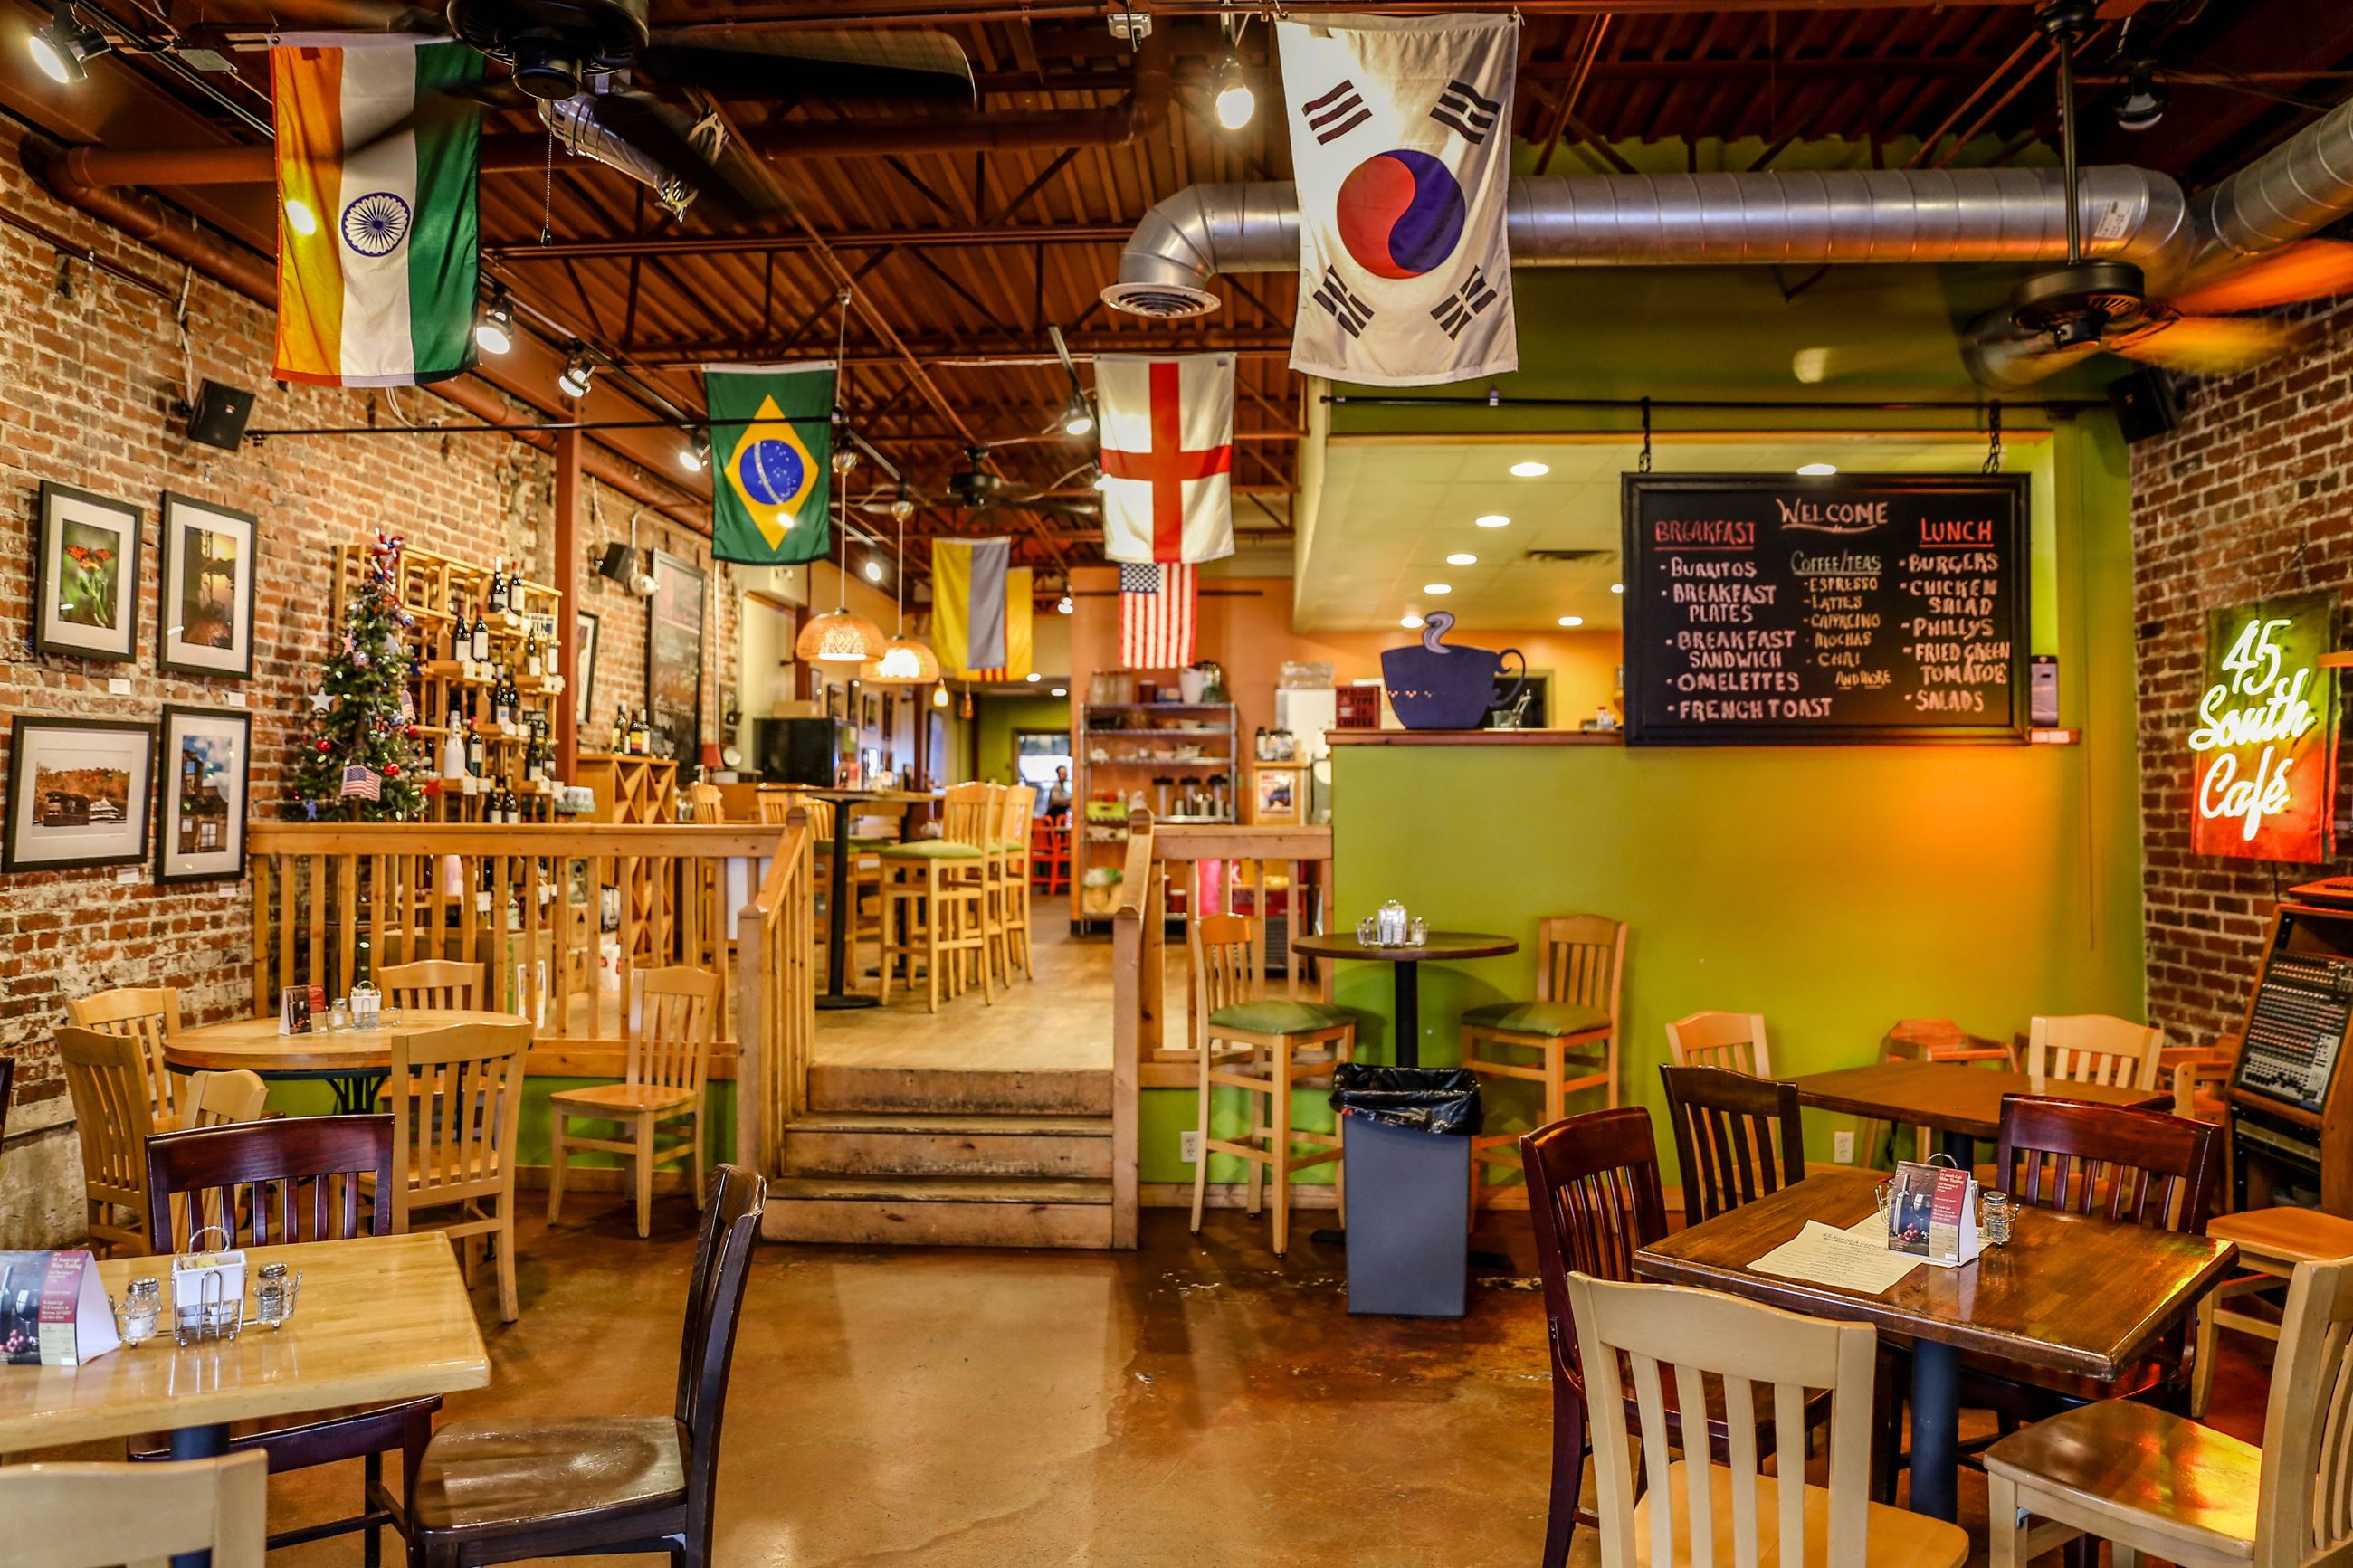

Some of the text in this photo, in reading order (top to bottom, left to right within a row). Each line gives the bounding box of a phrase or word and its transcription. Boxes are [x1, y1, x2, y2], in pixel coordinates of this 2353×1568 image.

[1776, 497, 1889, 525] WELCOME
[1654, 520, 1756, 545] BREAKFAST
[1920, 517, 1993, 542] LUNCH
[1671, 556, 1758, 579] BURRITOS
[1909, 552, 1999, 575] BURGERS
[1673, 584, 1777, 605] BREAKFAST
[1809, 576, 1879, 593] ESPRESSO
[1910, 578, 1998, 599] CHICKEN
[1688, 603, 1755, 624] PLATES
[1812, 594, 1863, 613] LATTES
[1929, 596, 1993, 616] SALAD
[1913, 616, 1995, 641] PHILLYS
[1677, 630, 1796, 651] BREAKFAST
[1815, 631, 1872, 649] MOCHAS
[1688, 650, 1783, 669] SANDWICH
[1817, 651, 1862, 668] CHAI
[1915, 641, 2010, 663] FRIED GREEN
[2222, 619, 2292, 696] 45
[1677, 672, 1800, 693] OMELETTES
[1679, 697, 1834, 722] FRENCH TOAST
[1915, 689, 1985, 713] SALADS
[2187, 668, 2319, 752] South
[1338, 717, 1375, 728] COFFEE
